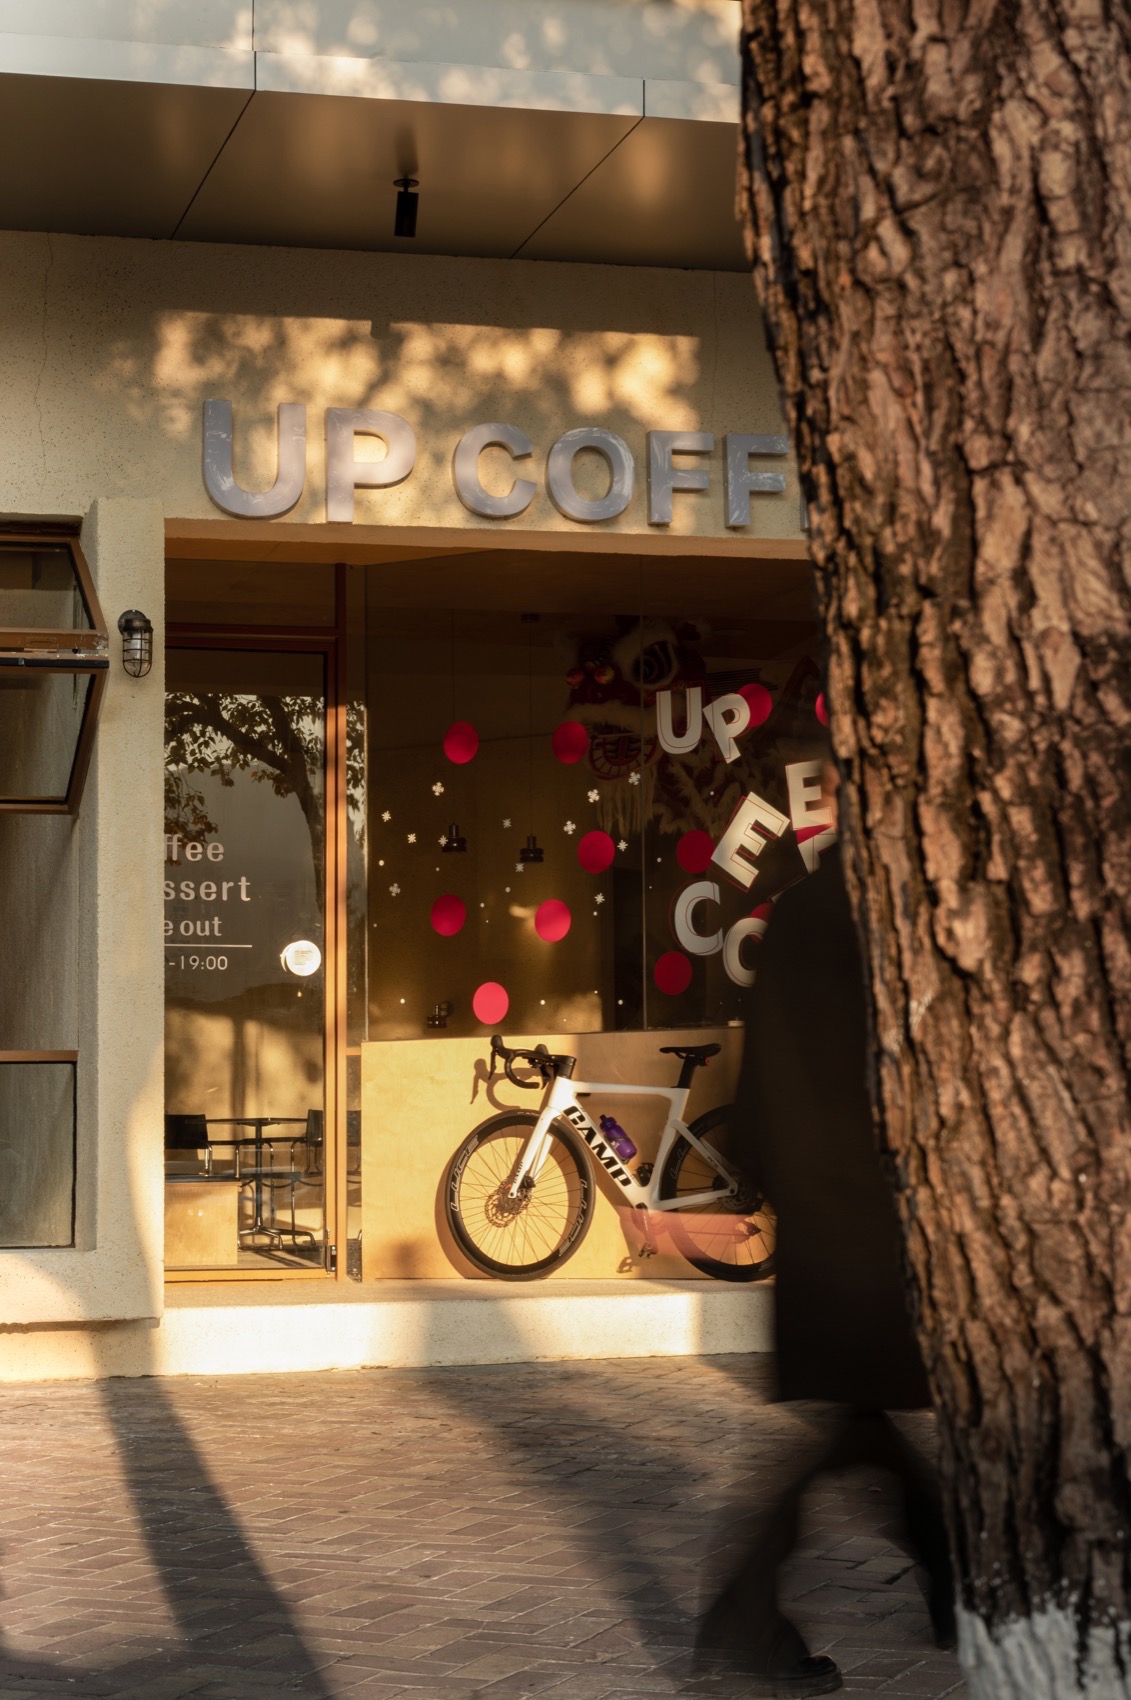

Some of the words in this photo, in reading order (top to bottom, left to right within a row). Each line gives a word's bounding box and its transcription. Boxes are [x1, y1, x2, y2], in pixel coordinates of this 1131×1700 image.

[203, 398, 416, 523] UP
[452, 422, 809, 532] COFF
[654, 686, 751, 764] UP
[179, 916, 223, 937] out
[562, 1105, 632, 1187] CAMP
